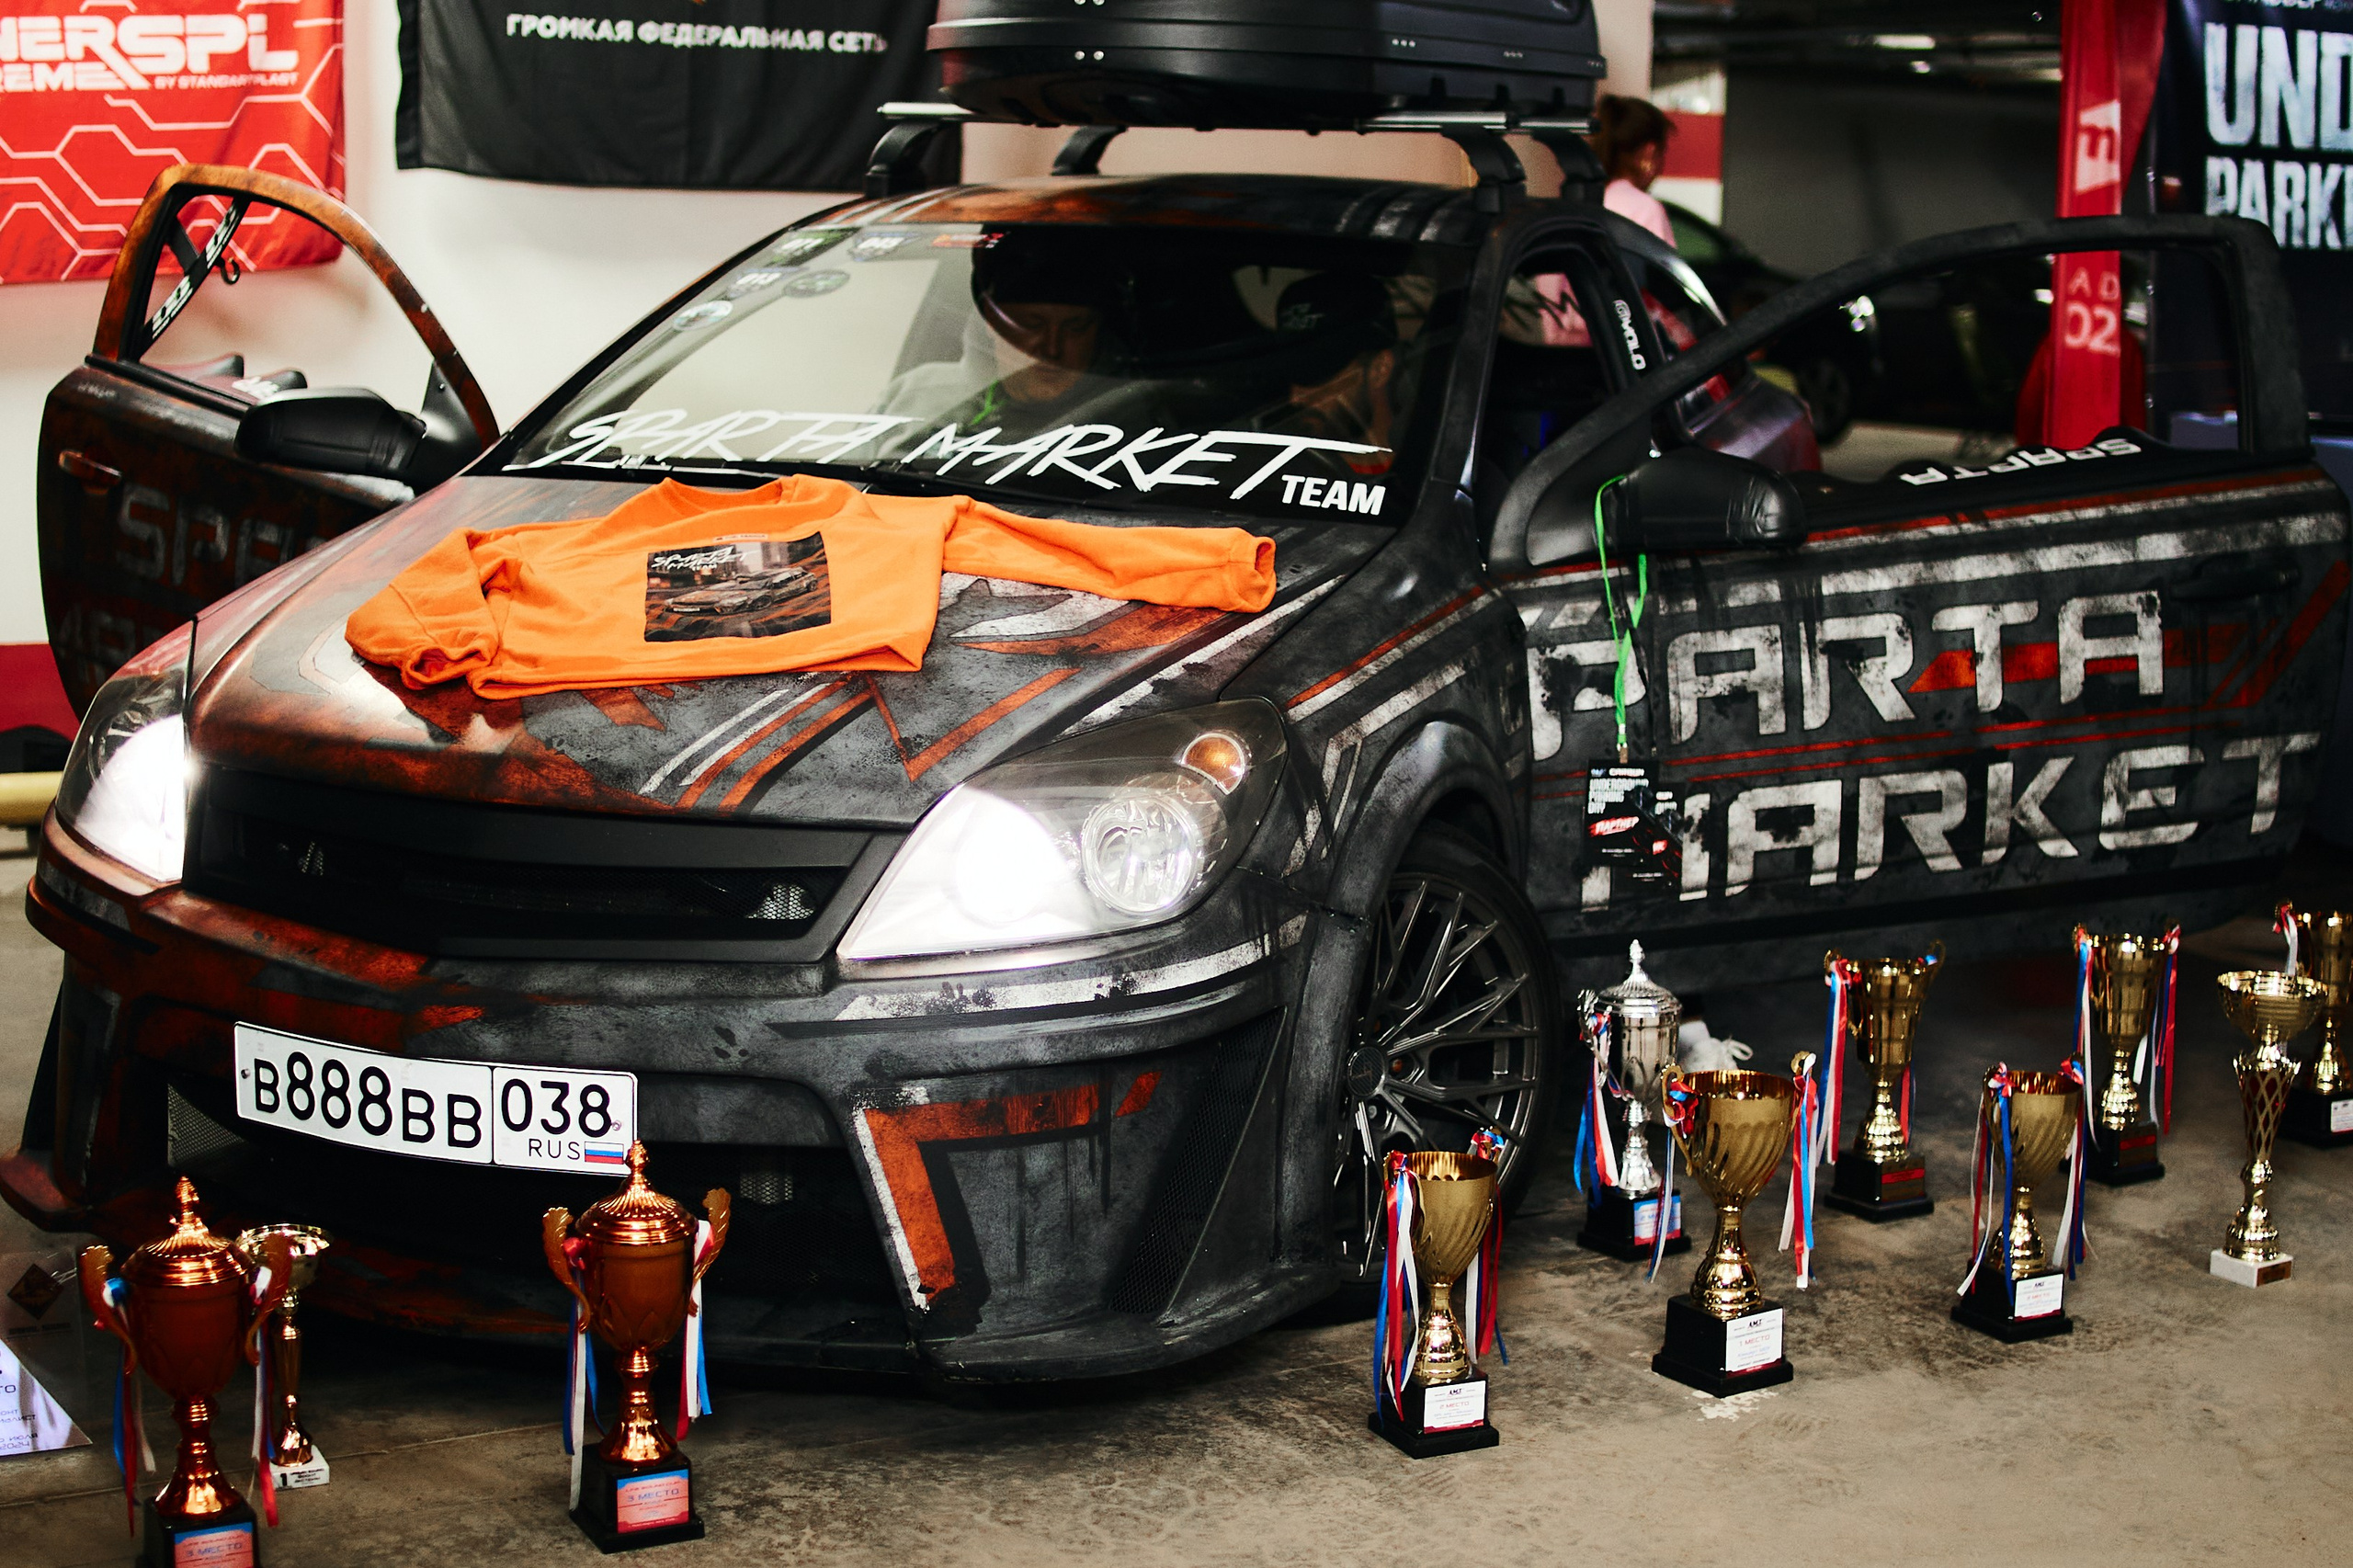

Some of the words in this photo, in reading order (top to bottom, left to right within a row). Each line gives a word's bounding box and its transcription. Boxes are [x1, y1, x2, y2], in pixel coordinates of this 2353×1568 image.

[506, 14, 634, 42] ГРОМКАЯ
[637, 20, 825, 51] ФЕДЕРАЛЬНАЯ
[828, 30, 889, 53] СЕТЬ
[501, 408, 925, 472] SPARTA
[900, 423, 1393, 500] MARKET
[1281, 474, 1386, 516] TEAM
[1587, 802, 1606, 814] DAY
[501, 1078, 612, 1138] 038
[529, 1138, 581, 1161] RUS
